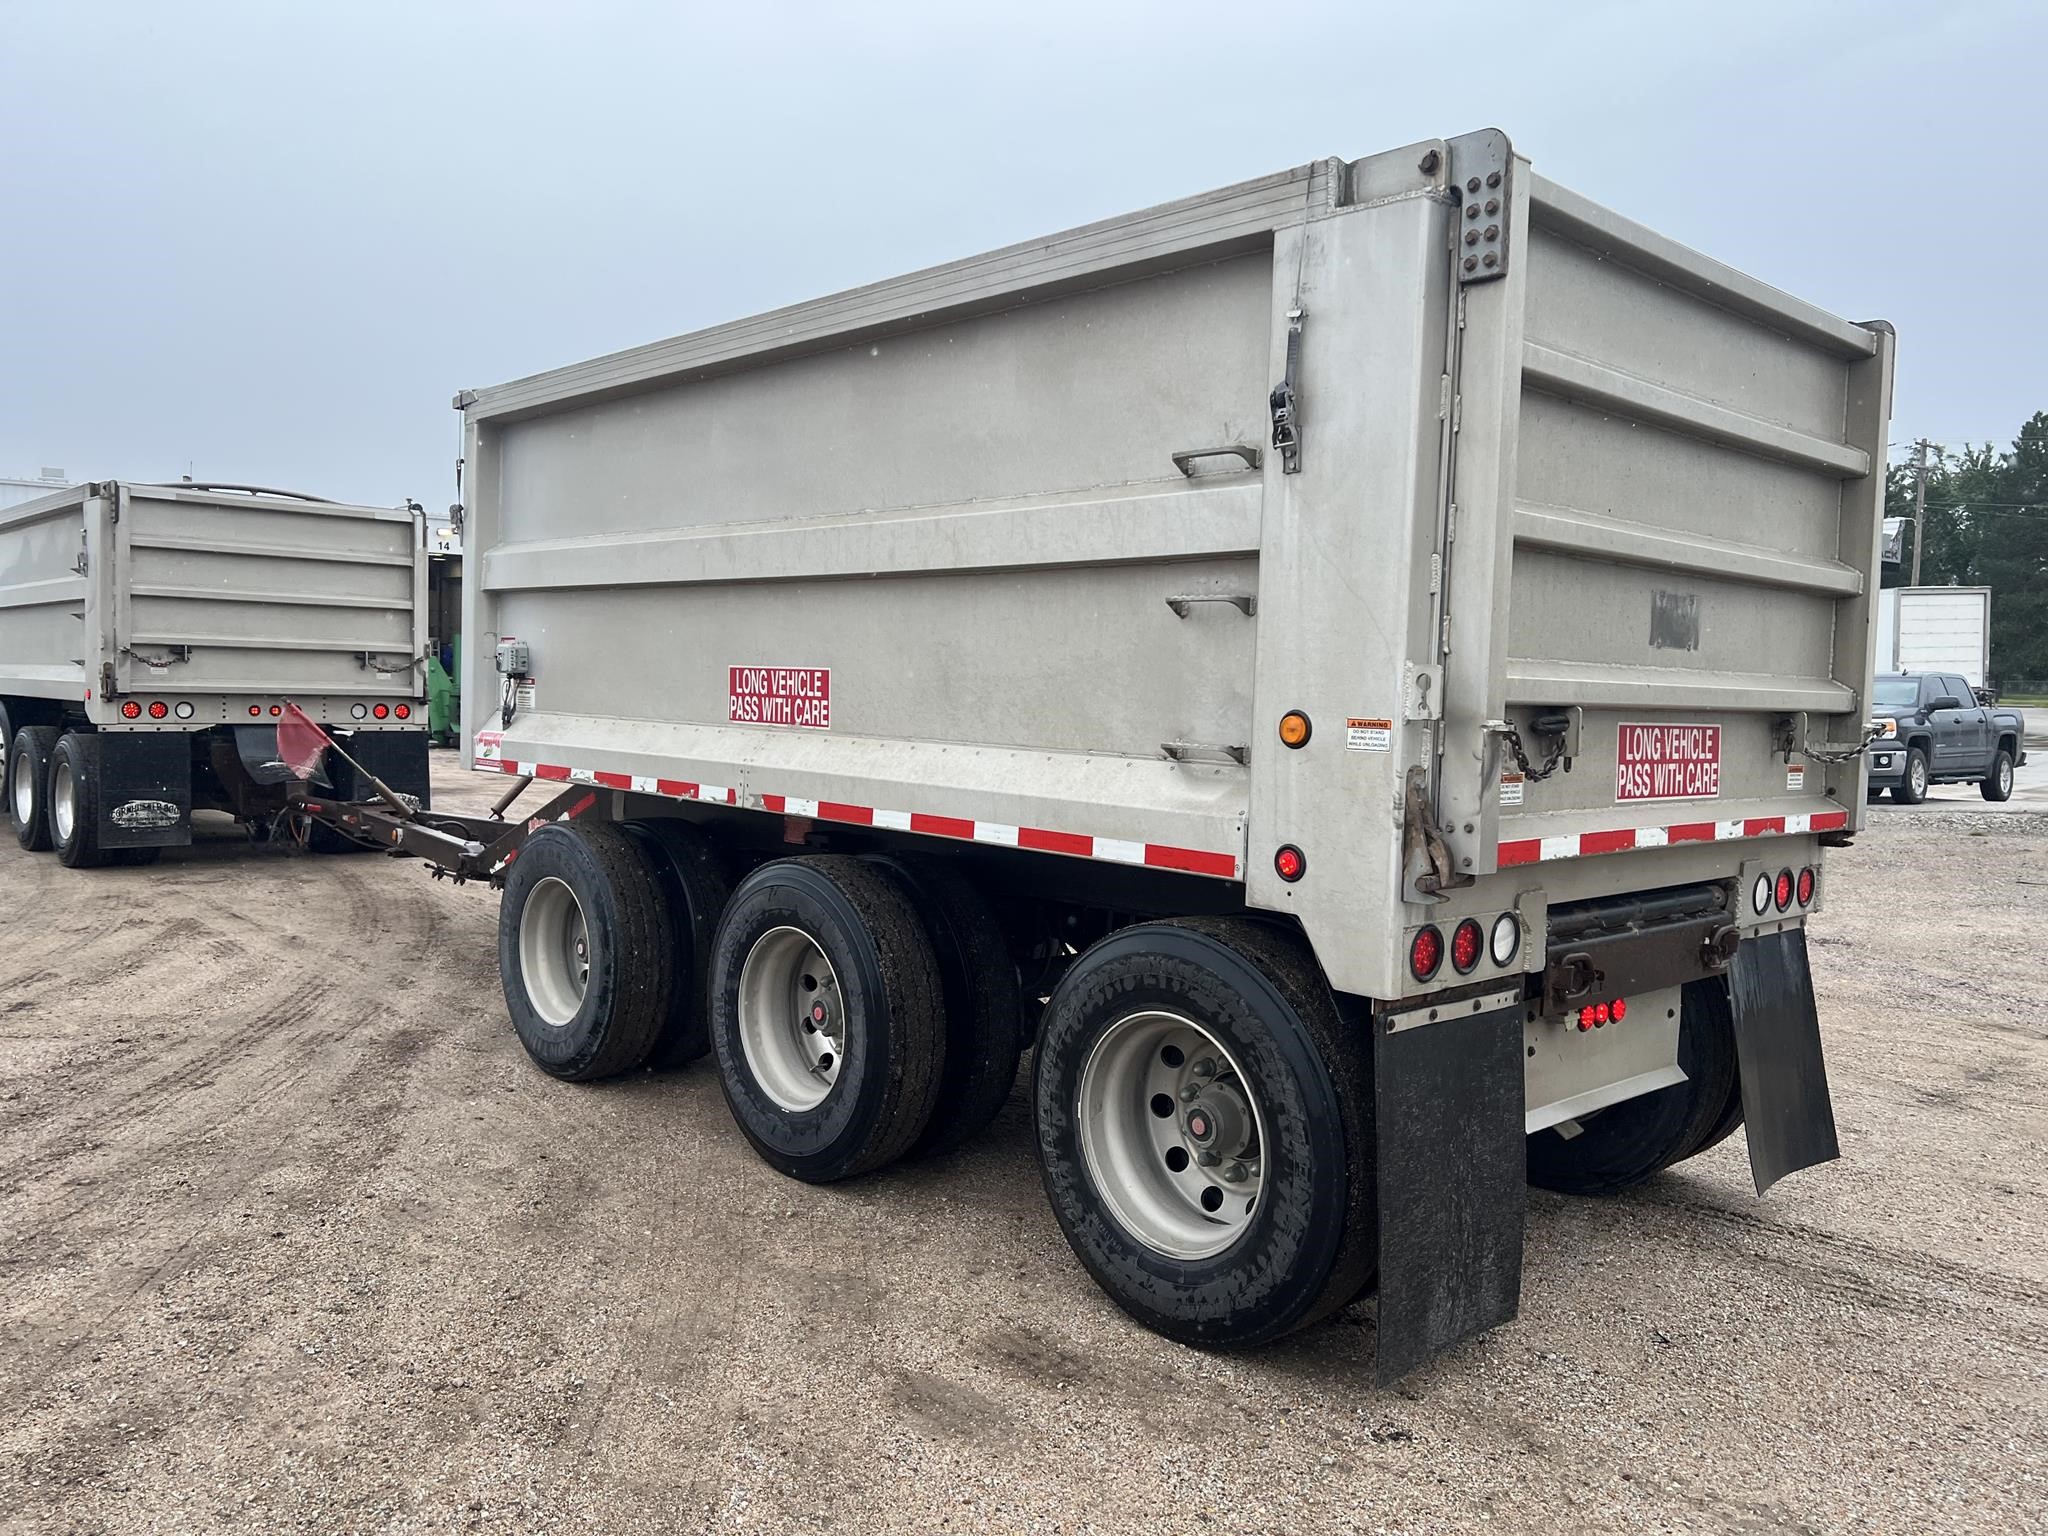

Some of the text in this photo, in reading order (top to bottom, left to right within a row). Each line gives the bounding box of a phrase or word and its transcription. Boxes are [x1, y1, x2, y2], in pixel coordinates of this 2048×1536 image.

[438, 541, 450, 551] 14
[735, 668, 822, 697] LONG VEHICLE
[730, 695, 829, 726] PASS WITH CARE
[1625, 727, 1713, 761] LONG VEHICLE
[1618, 762, 1718, 797] PASS WITH CARE
